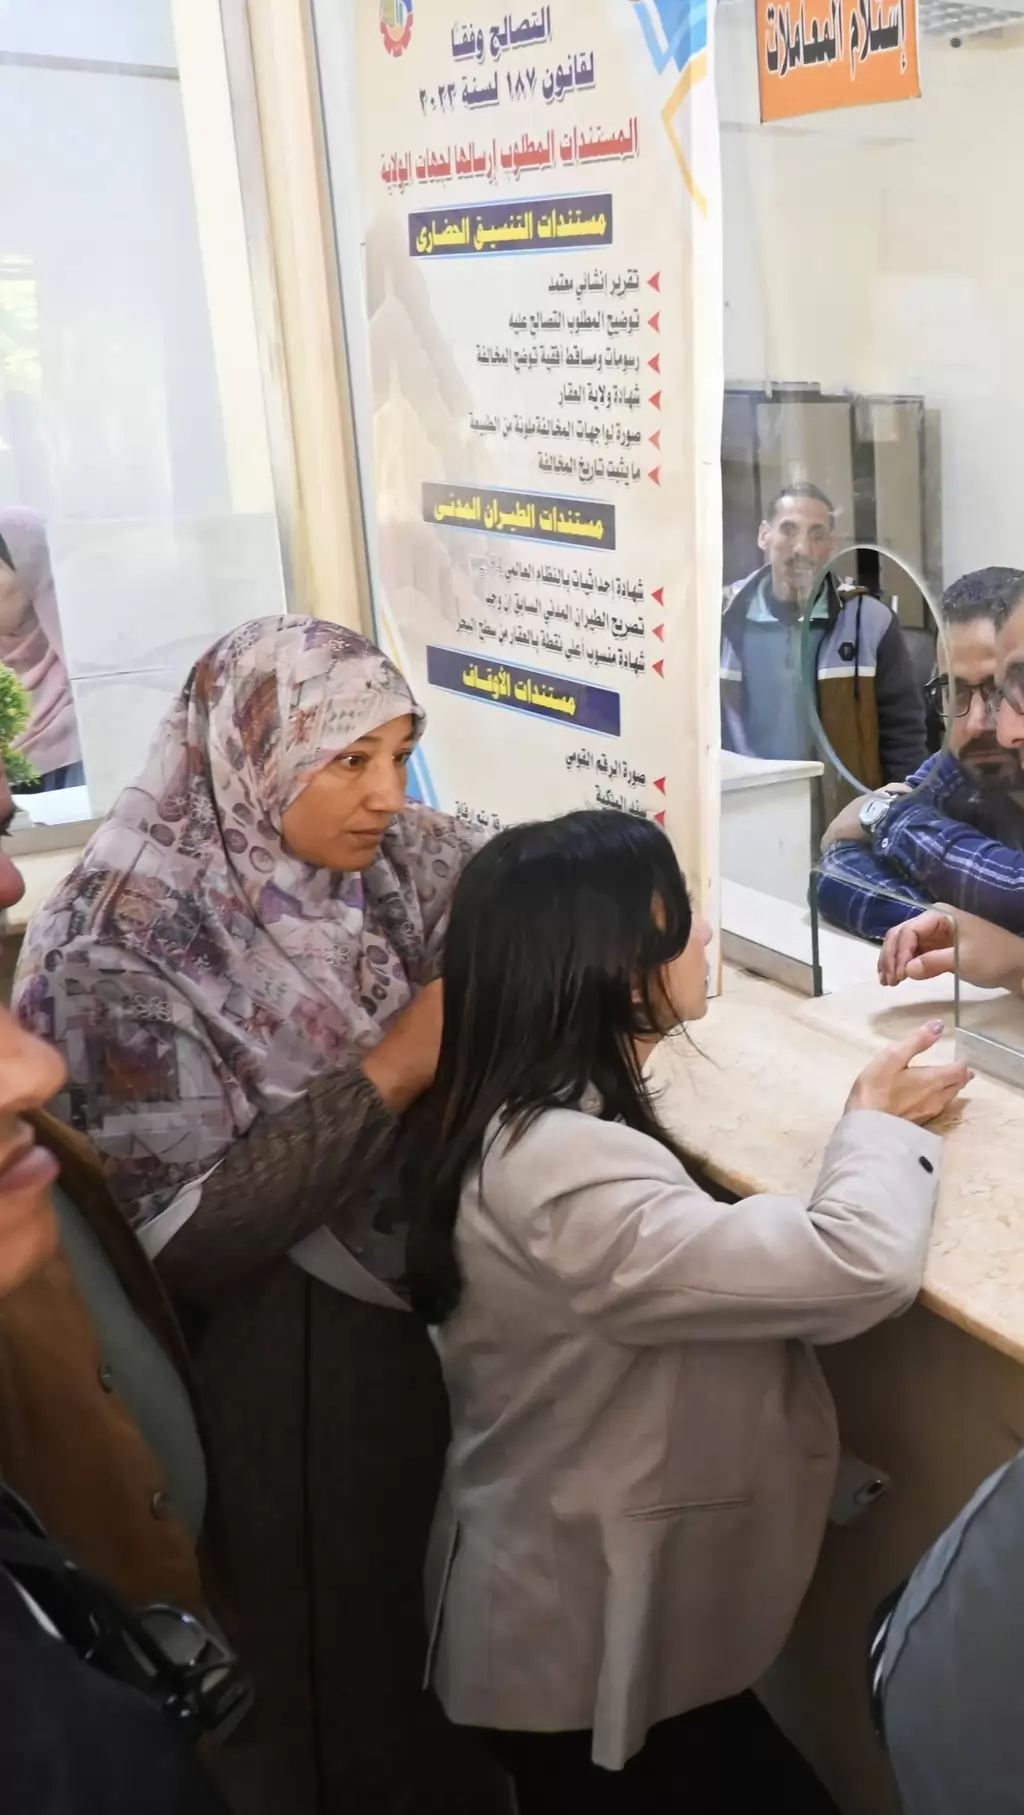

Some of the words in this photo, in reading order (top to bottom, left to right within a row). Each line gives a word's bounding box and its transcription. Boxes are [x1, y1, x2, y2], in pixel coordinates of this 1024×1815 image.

[488, 4, 553, 58] التصالح
[766, 0, 844, 77] المعاملات
[462, 70, 499, 108] لسنة
[507, 66, 537, 101] ١٨٧
[542, 50, 595, 102] لقانون
[560, 116, 638, 164] المستندات
[415, 145, 451, 185] لجهات
[455, 138, 497, 184] إرسالها
[501, 130, 555, 179] المطلوب
[381, 151, 412, 194] الولاية
[474, 211, 533, 251] التنسيق
[537, 208, 606, 240] مستندات
[548, 273, 573, 292] معتمد
[610, 269, 639, 296] تقرير
[530, 310, 564, 336] التصالح
[568, 310, 604, 333] المطلوب
[607, 308, 639, 336] توضيح
[476, 345, 511, 366] المخالفة
[566, 345, 602, 371] ومساقط
[605, 347, 639, 371] رسومات
[558, 382, 585, 406] العقار
[587, 382, 611, 410] ولاية
[613, 383, 640, 409] شهادة
[616, 422, 641, 447] صورة
[538, 452, 577, 475] المخالفة
[578, 456, 604, 482] تاريخ
[607, 457, 628, 485] يثبت
[632, 460, 641, 480] ما
[484, 499, 535, 531] الطيران
[539, 506, 604, 541] مستندات
[616, 578, 644, 603] شهادة
[574, 607, 609, 632] الطيران
[611, 617, 645, 639] تصريح
[510, 625, 539, 653] بالعقار
[541, 629, 563, 653] نقطة
[587, 646, 616, 666] منسوب
[618, 648, 646, 676] شهادة
[514, 678, 577, 717] مستندات
[565, 747, 594, 772] القومي
[596, 752, 622, 778] الرقم
[622, 760, 647, 789] صورة
